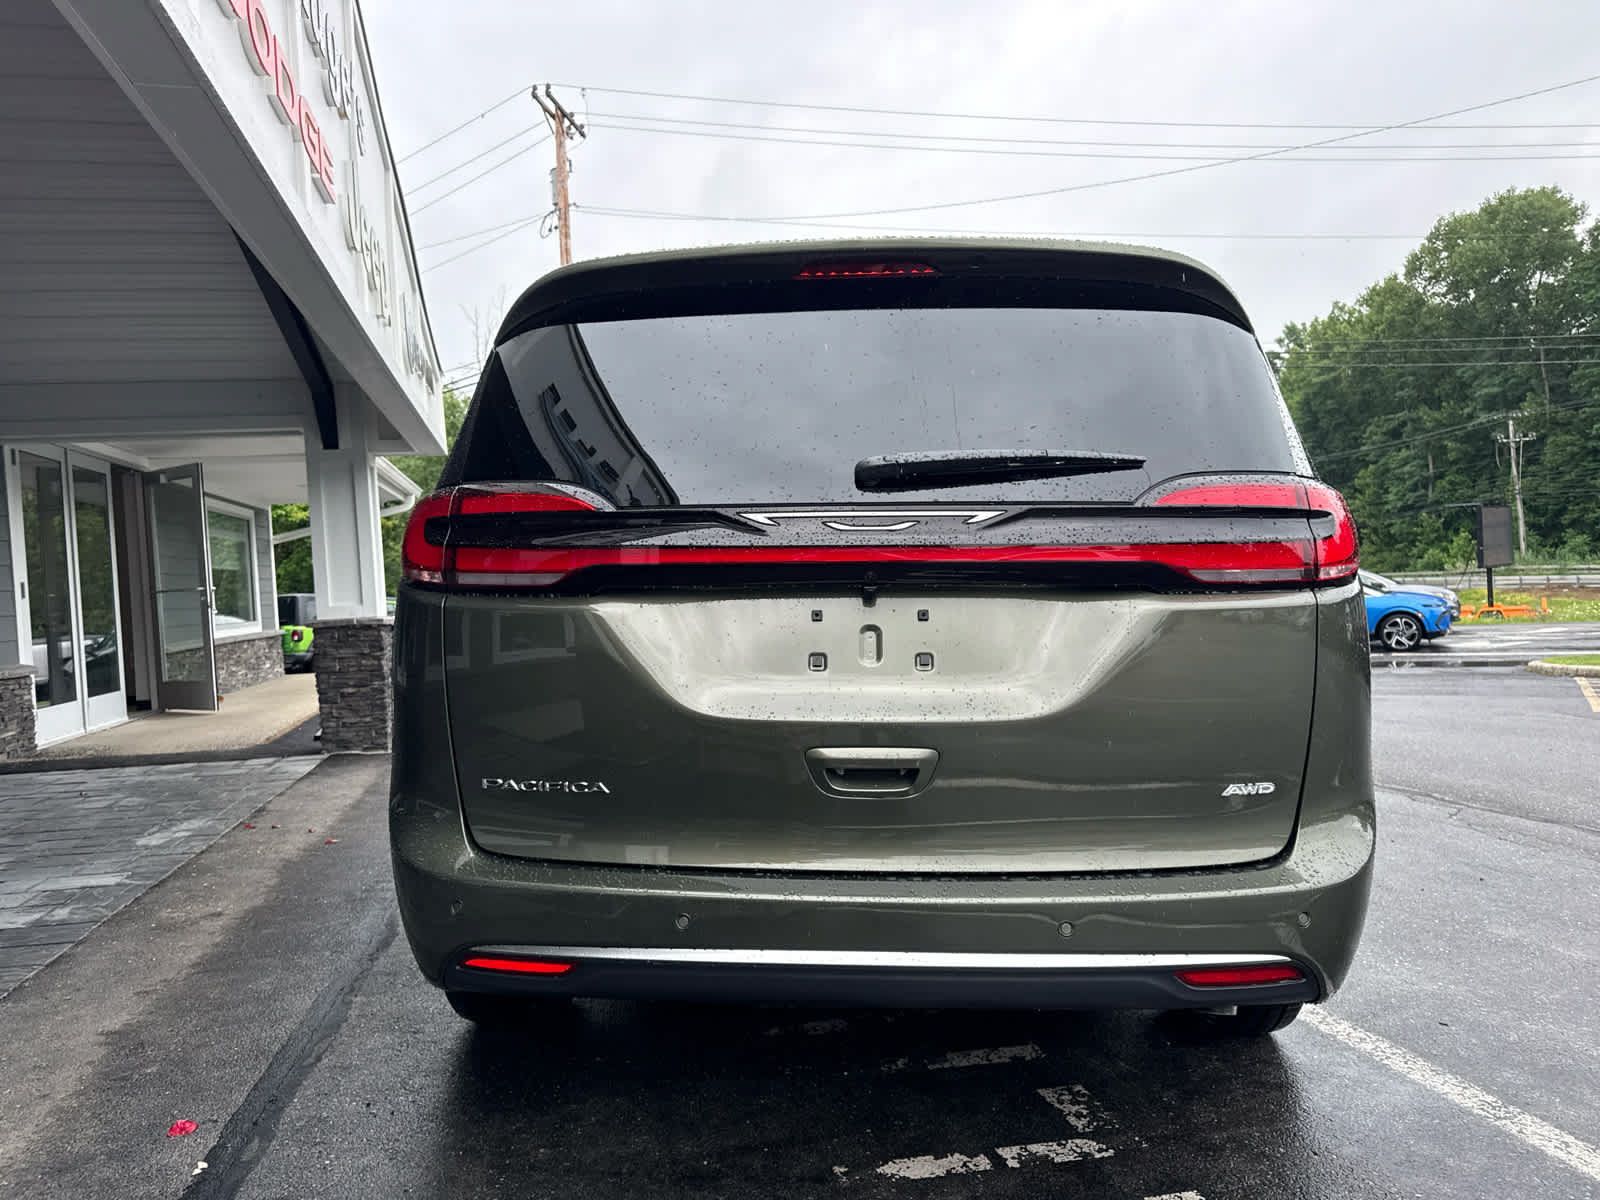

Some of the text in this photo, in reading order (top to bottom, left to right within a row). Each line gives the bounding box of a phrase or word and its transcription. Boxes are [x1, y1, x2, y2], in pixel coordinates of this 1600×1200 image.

[218, 0, 336, 204] ODGE
[481, 777, 611, 794] PACIFICA
[1220, 782, 1276, 797] AWD
